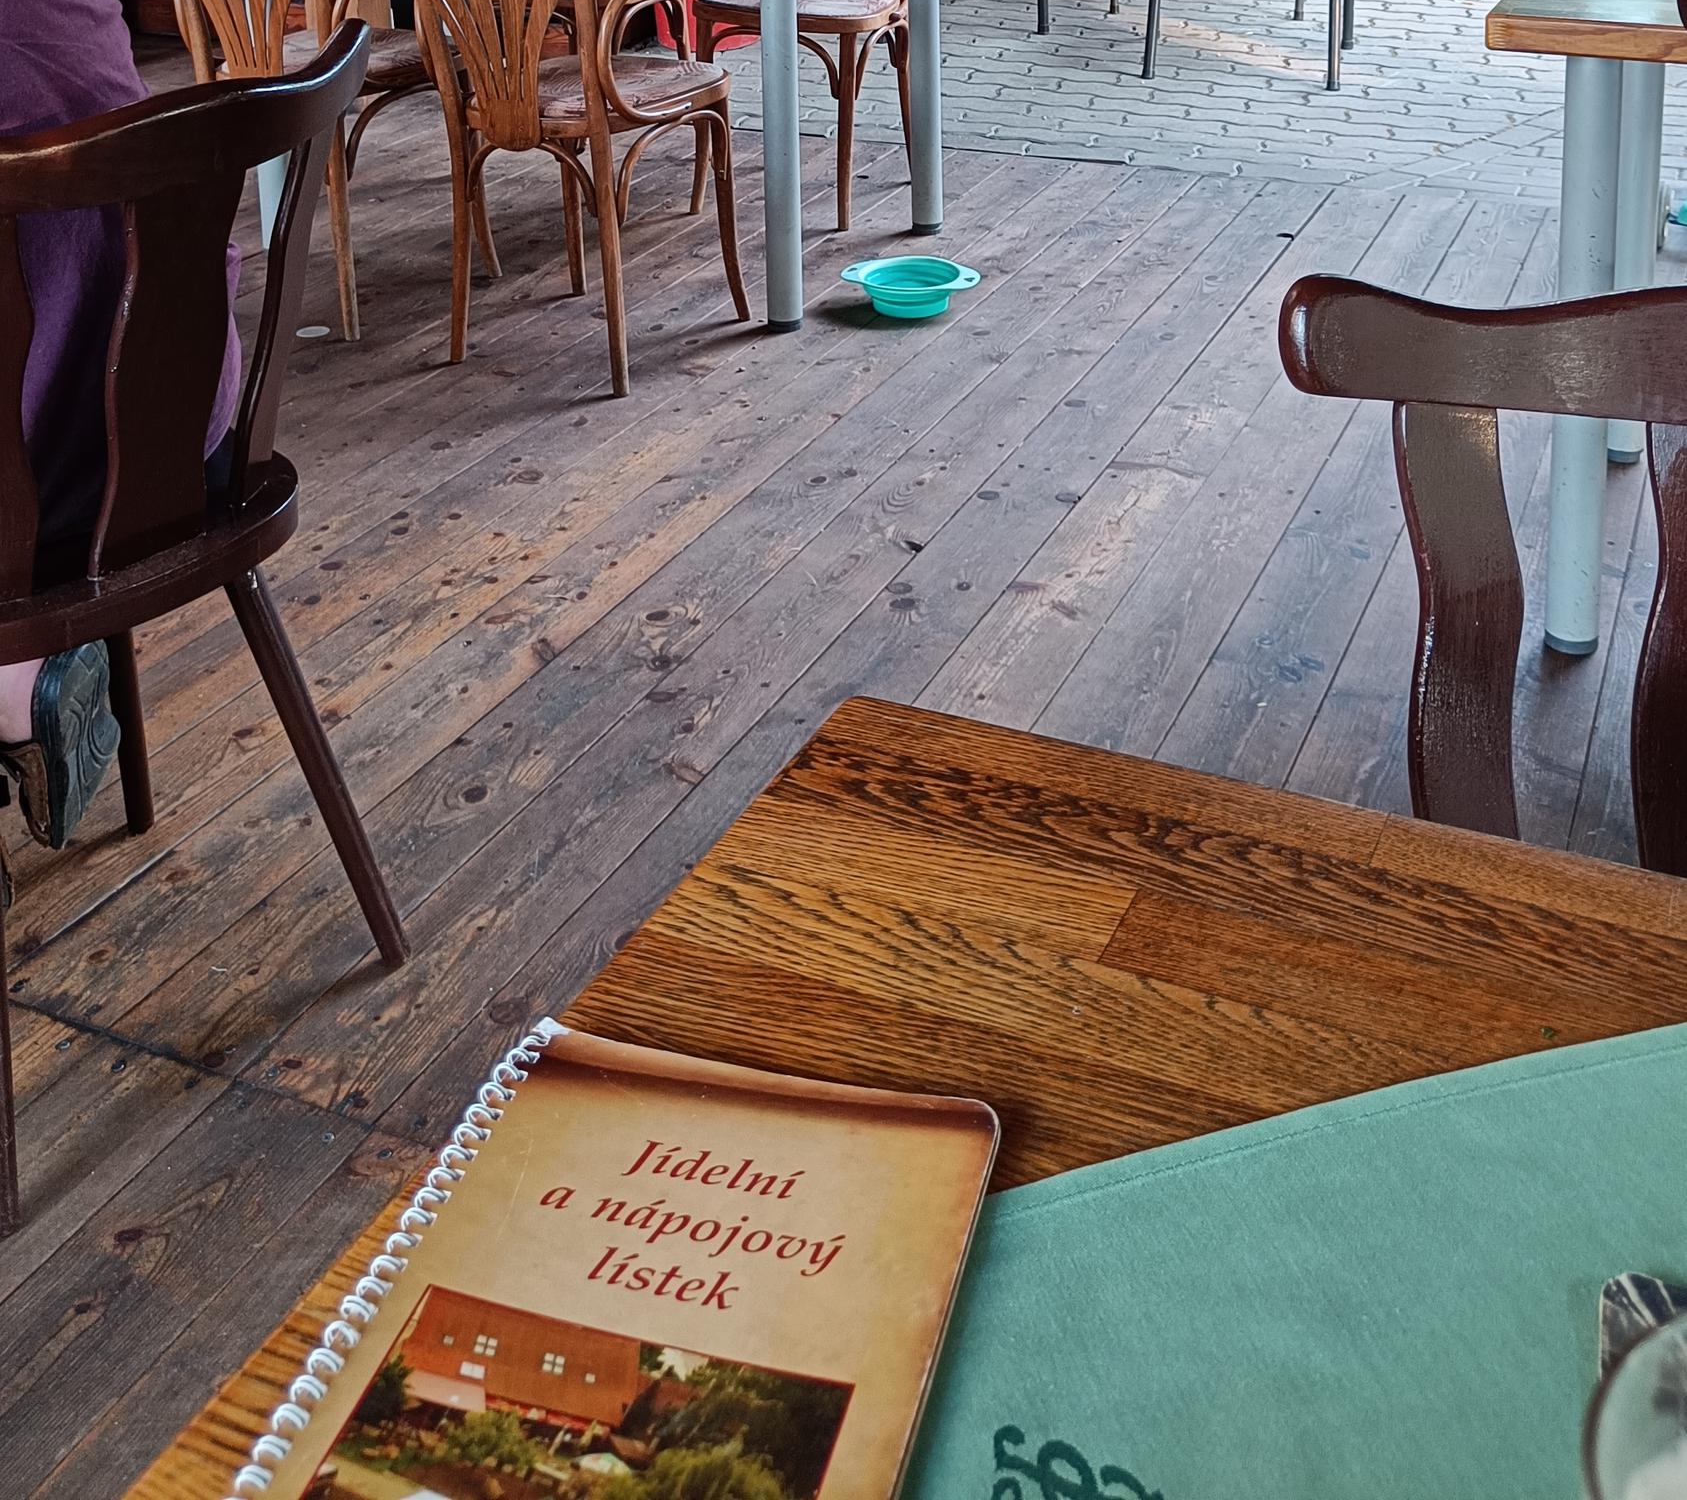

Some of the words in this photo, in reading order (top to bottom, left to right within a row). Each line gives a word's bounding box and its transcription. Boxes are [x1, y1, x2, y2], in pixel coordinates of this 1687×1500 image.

[621, 1138, 806, 1200] Jídelní
[539, 1186, 576, 1211] a
[590, 1197, 846, 1276] nápojový
[586, 1246, 741, 1311] lístek
